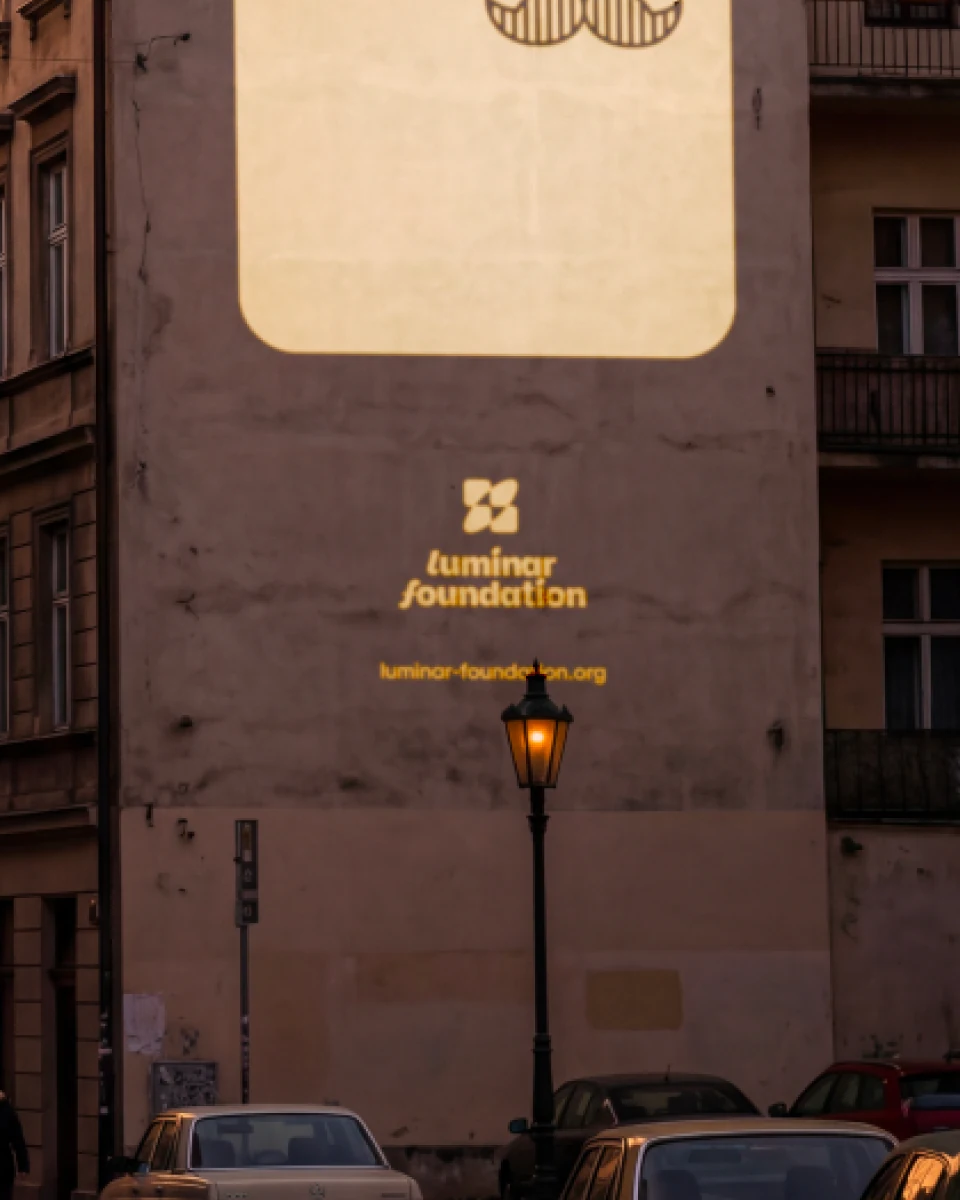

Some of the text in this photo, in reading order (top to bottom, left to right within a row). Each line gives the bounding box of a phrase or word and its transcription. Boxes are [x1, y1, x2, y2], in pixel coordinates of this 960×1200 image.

[426, 546, 558, 577] luminar
[398, 578, 588, 610] foundation
[379, 661, 607, 686] luminar-foundaion.org
